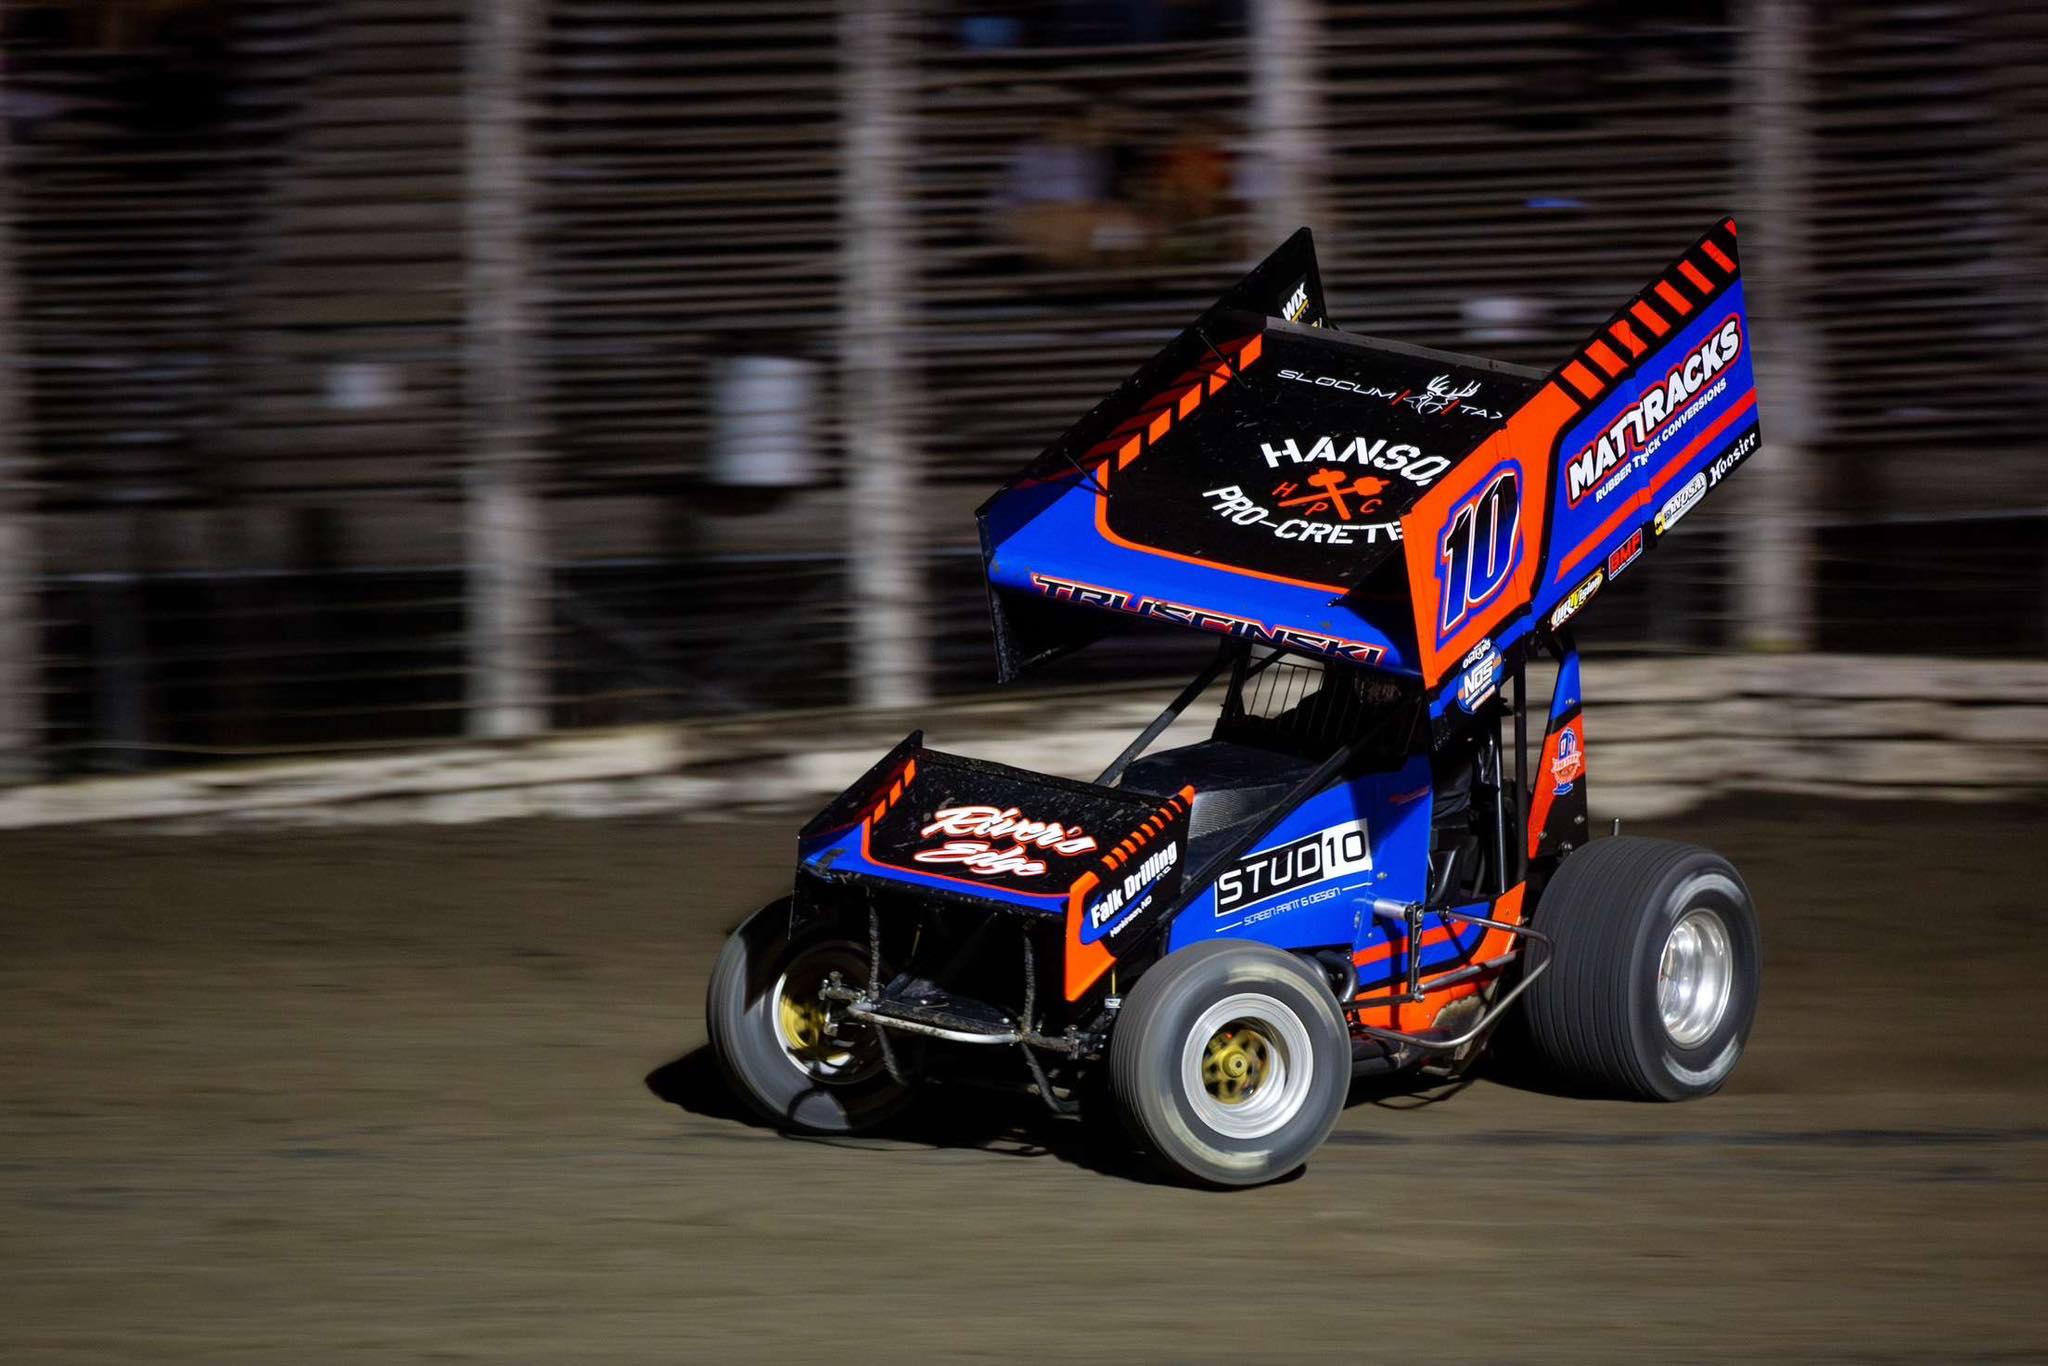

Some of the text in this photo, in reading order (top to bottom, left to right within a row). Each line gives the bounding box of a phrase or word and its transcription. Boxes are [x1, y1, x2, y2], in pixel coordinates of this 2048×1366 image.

[1282, 282, 1307, 320] WIX
[1277, 369, 1396, 400] SLOCUM
[1569, 320, 1740, 500] MATTRACKS
[1260, 436, 1451, 486] HANSO
[1595, 463, 1632, 503] RUBBER
[1662, 378, 1728, 441] CONVERSIONS
[1708, 432, 1756, 488] Hoosier
[1441, 469, 1521, 637] 10
[1464, 651, 1496, 699] NOS
[921, 805, 1098, 857] River's
[1091, 841, 1177, 929] Falk Drilling
[1200, 829, 1367, 906] STUD10
[1244, 907, 1277, 926] SCREEN
[1276, 899, 1300, 915] PRINT
[1309, 887, 1341, 905] DESIGN
